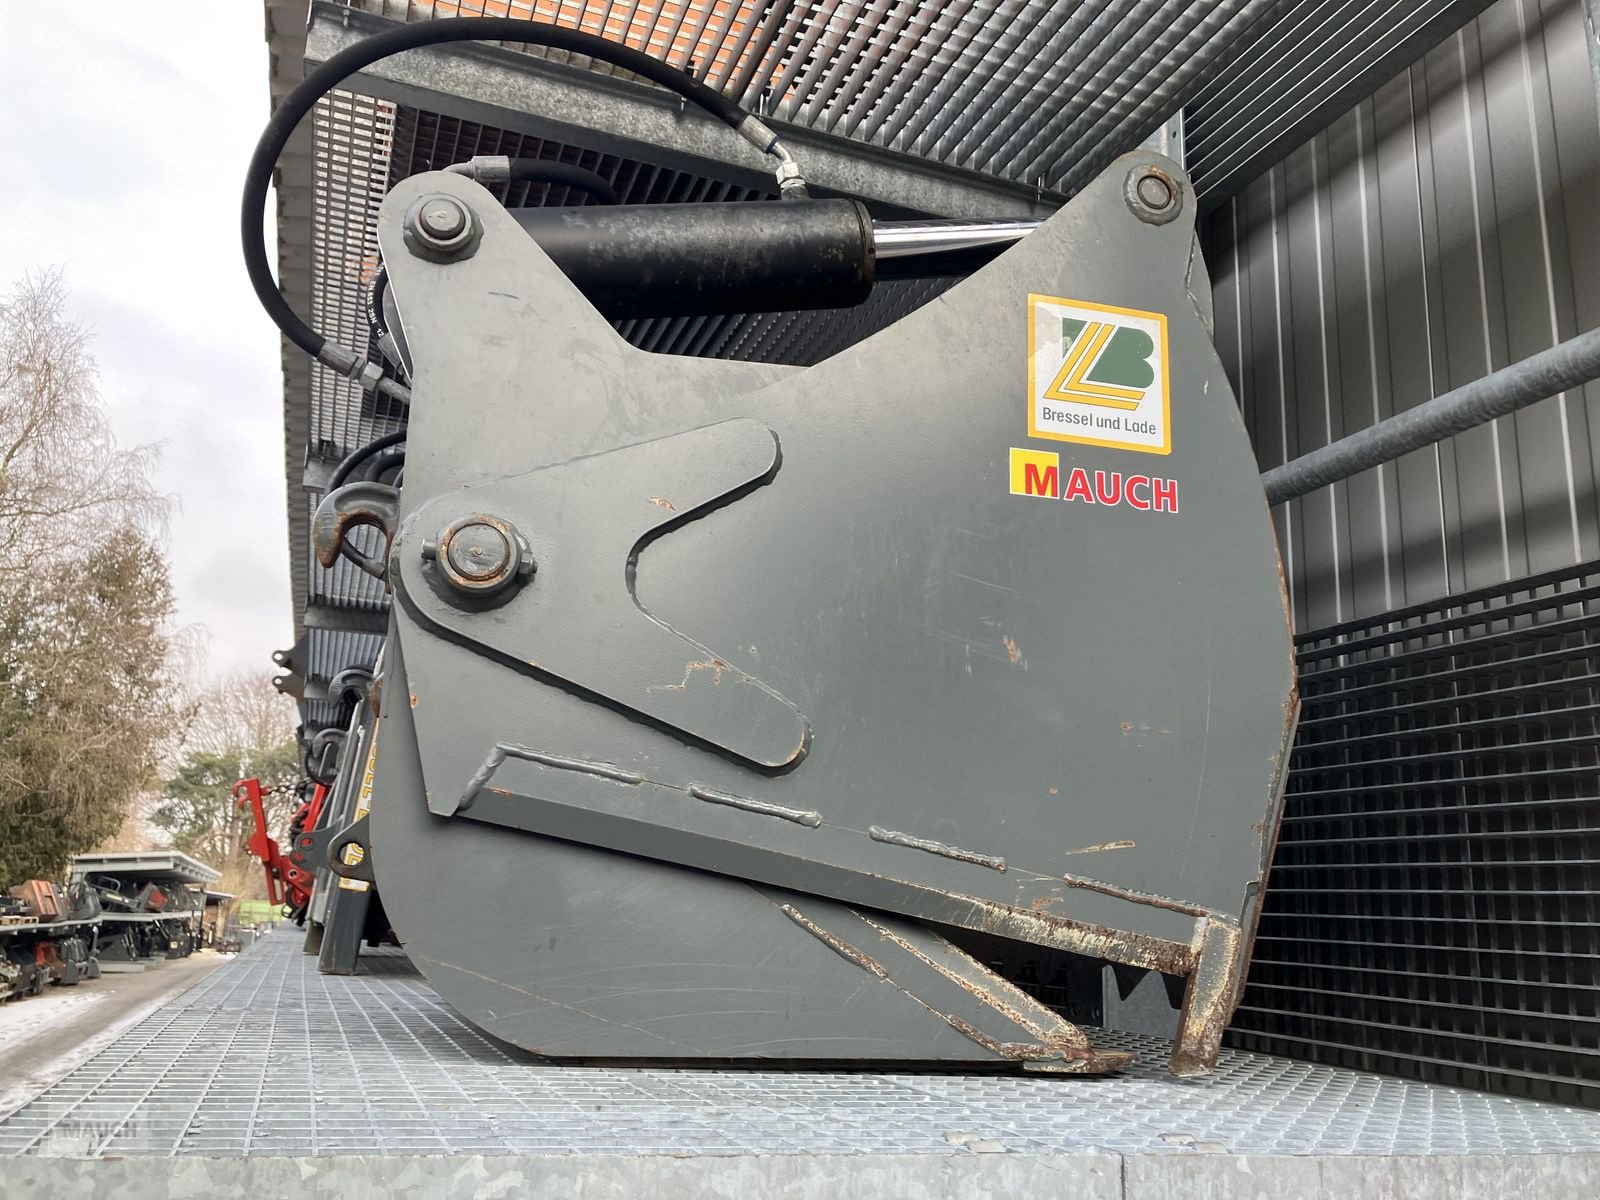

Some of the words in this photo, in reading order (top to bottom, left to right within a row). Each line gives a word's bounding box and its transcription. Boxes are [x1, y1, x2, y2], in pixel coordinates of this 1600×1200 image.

[377, 328, 384, 337] 12
[1042, 407, 1093, 426] Bressel
[1096, 417, 1121, 430] und
[1125, 418, 1157, 435] Lade
[1024, 463, 1179, 514] MAUCH
